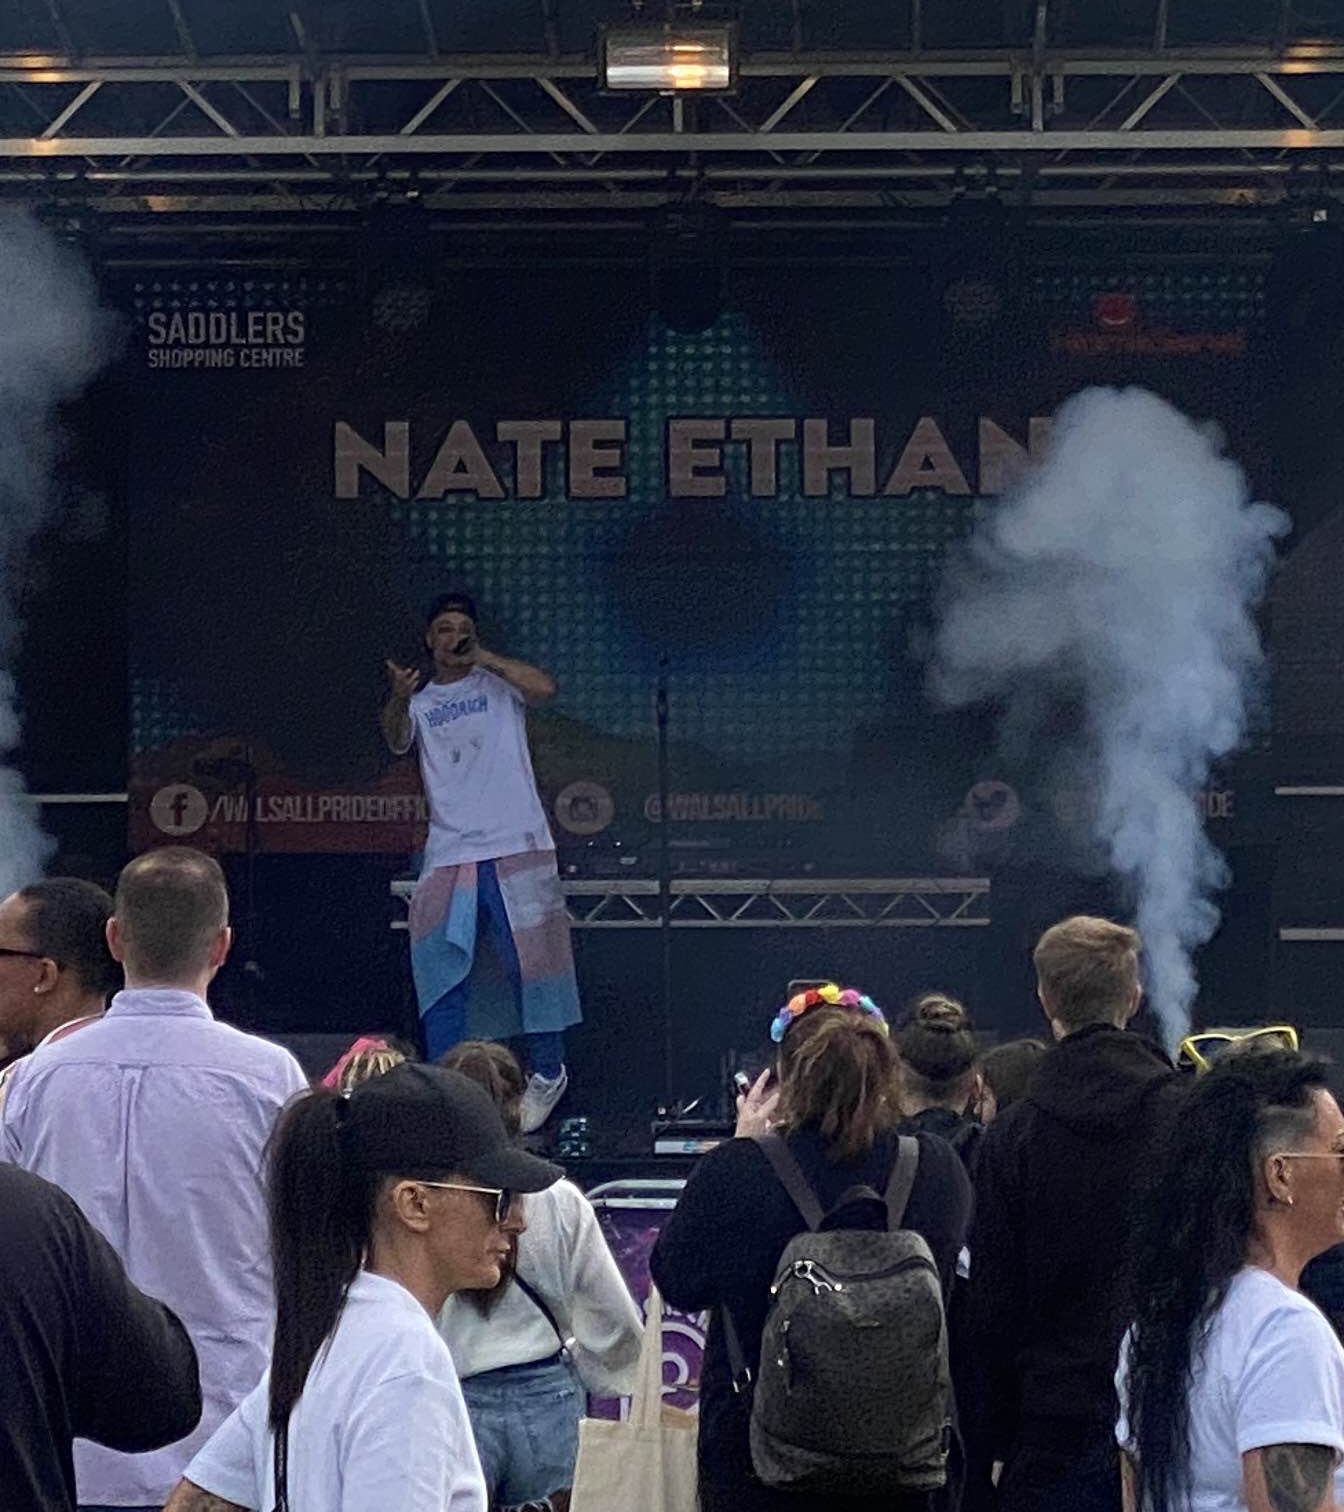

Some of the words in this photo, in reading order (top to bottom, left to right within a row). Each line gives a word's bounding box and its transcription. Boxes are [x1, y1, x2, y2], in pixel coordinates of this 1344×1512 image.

[148, 311, 304, 345] SADDLERS
[148, 349, 235, 368] SHOPPING
[240, 348, 305, 368] CENTRE
[334, 419, 628, 499] NATE
[668, 417, 1054, 497] ETHAN
